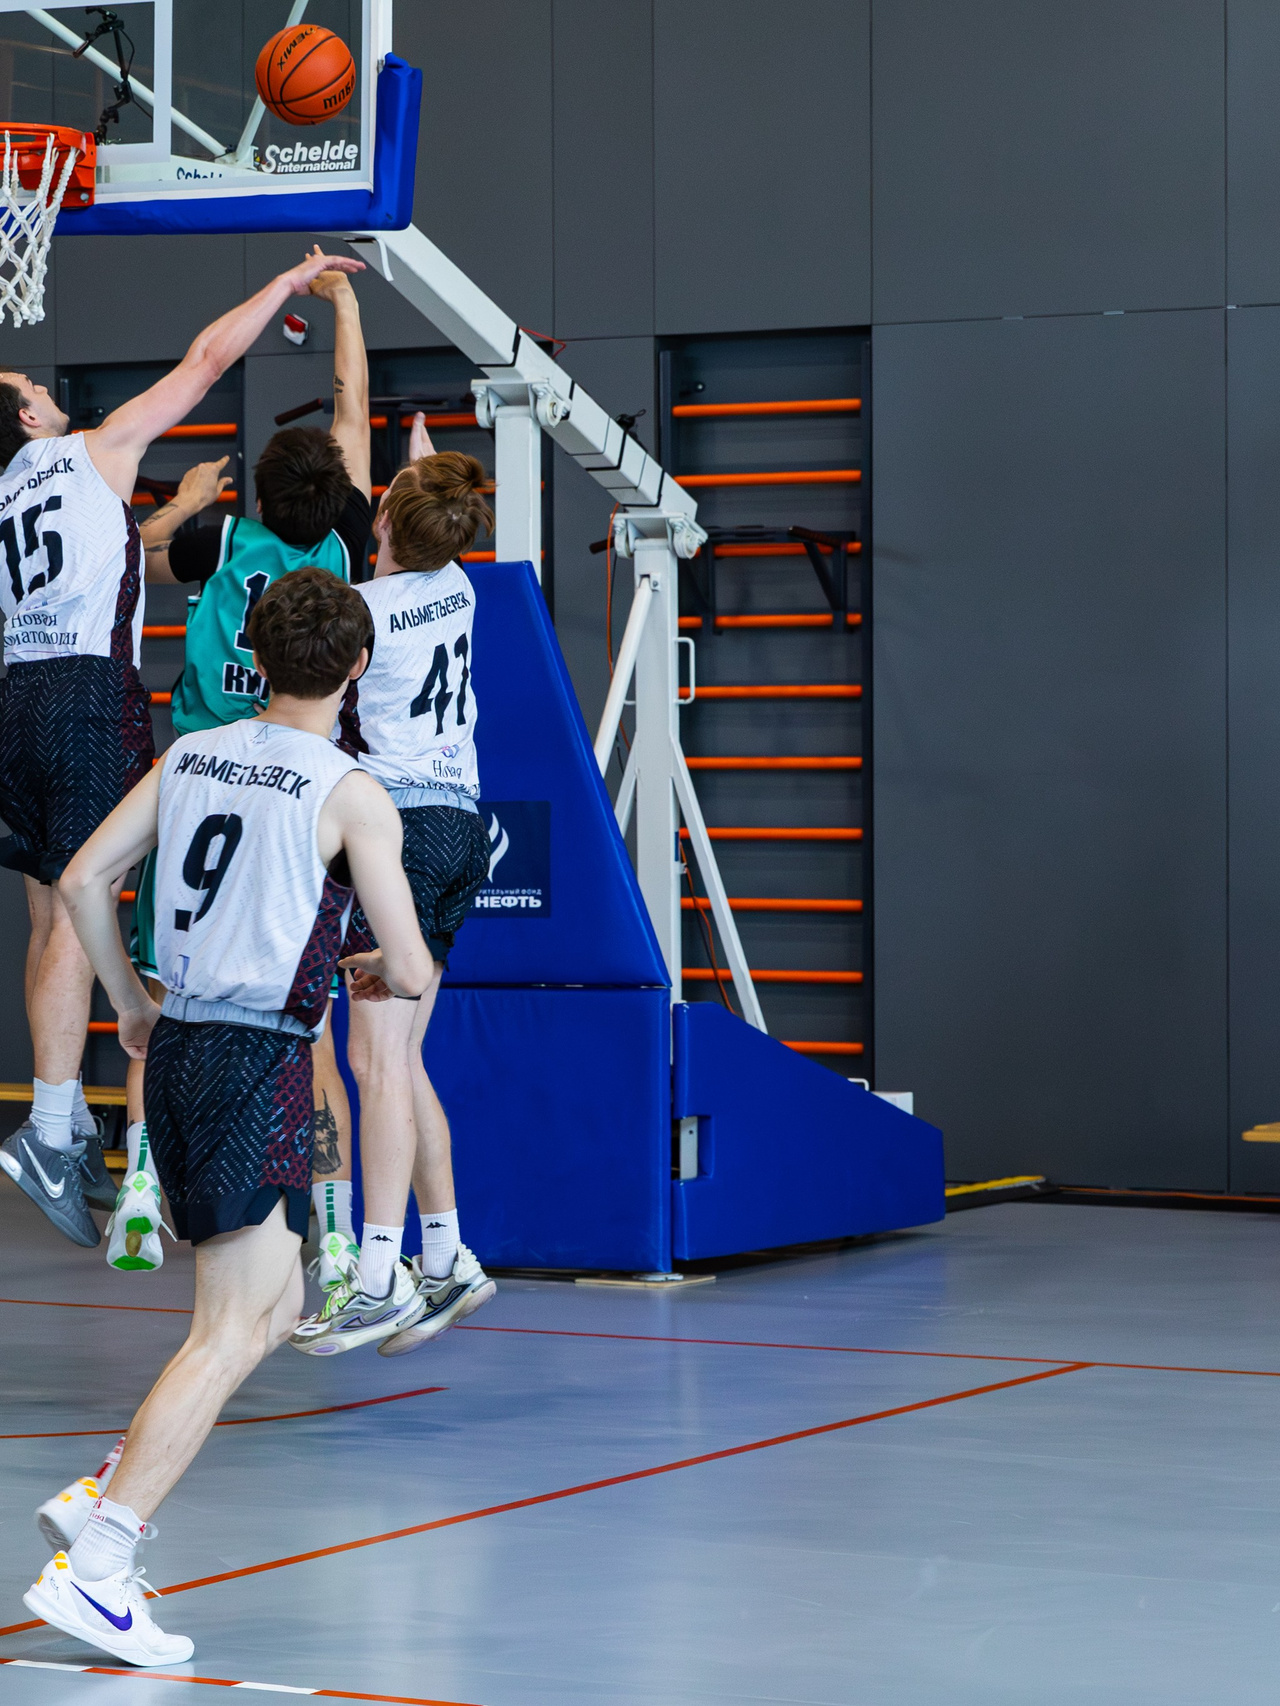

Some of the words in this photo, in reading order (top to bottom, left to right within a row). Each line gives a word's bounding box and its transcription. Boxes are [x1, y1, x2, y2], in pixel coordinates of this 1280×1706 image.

[261, 139, 358, 173] Schelde
[277, 159, 356, 173] international
[409, 632, 469, 736] 41
[173, 752, 312, 800] АЛЬМЕТЬЕВСК
[174, 812, 243, 932] 9
